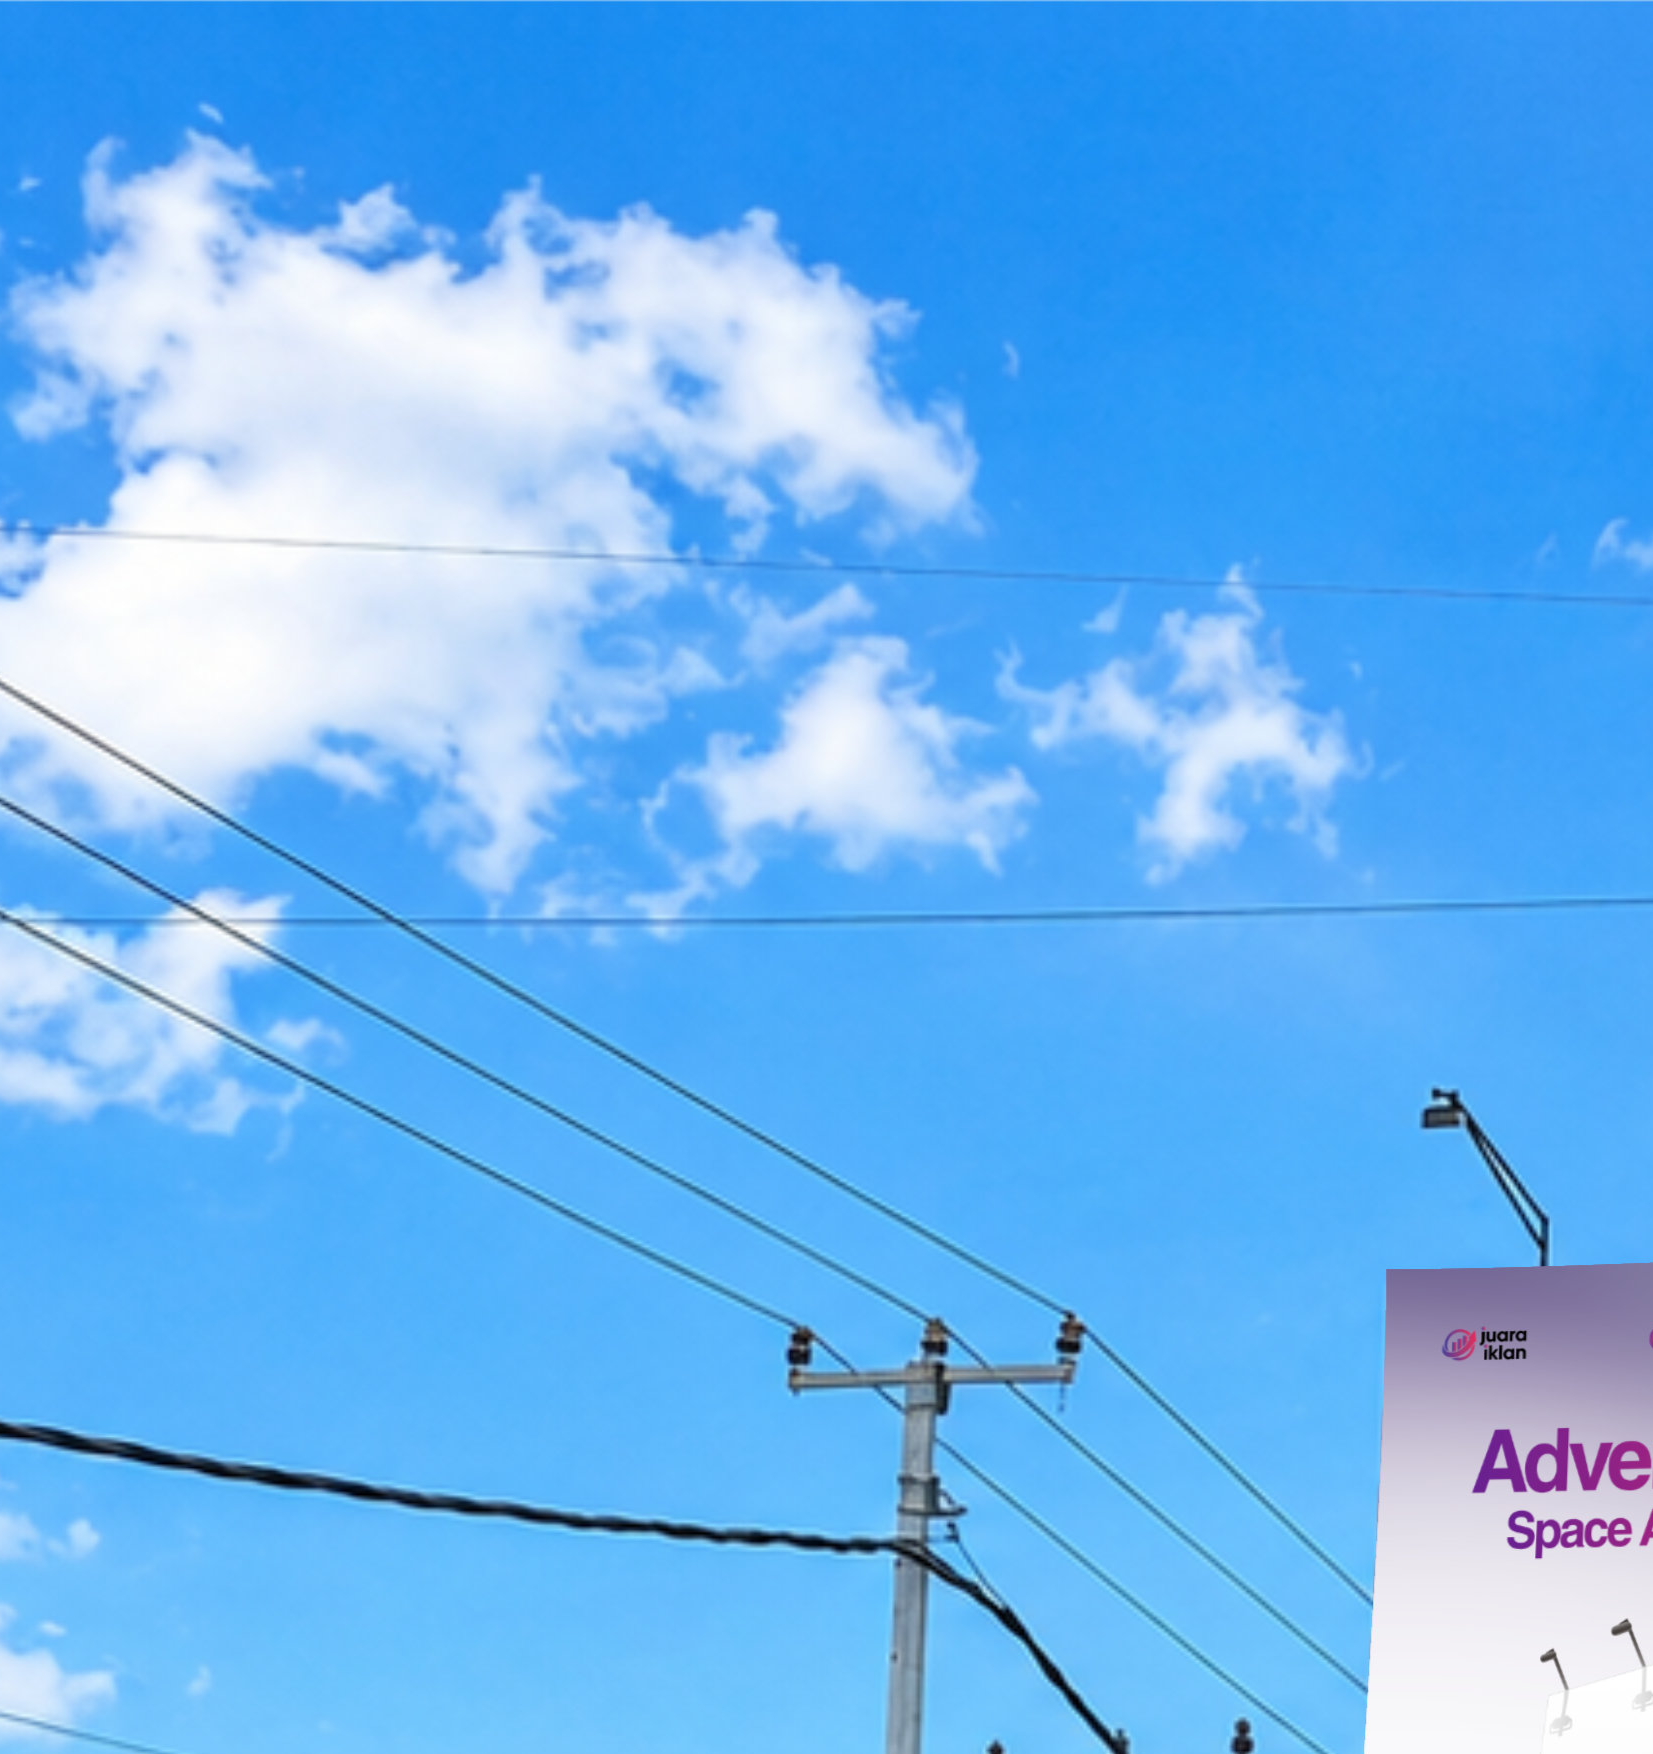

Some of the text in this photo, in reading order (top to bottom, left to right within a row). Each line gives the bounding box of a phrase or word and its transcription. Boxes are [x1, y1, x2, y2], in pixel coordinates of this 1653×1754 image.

[1480, 1326, 1527, 1346] juara
[1483, 1344, 1527, 1361] iklan
[1506, 1510, 1633, 1559] Space
